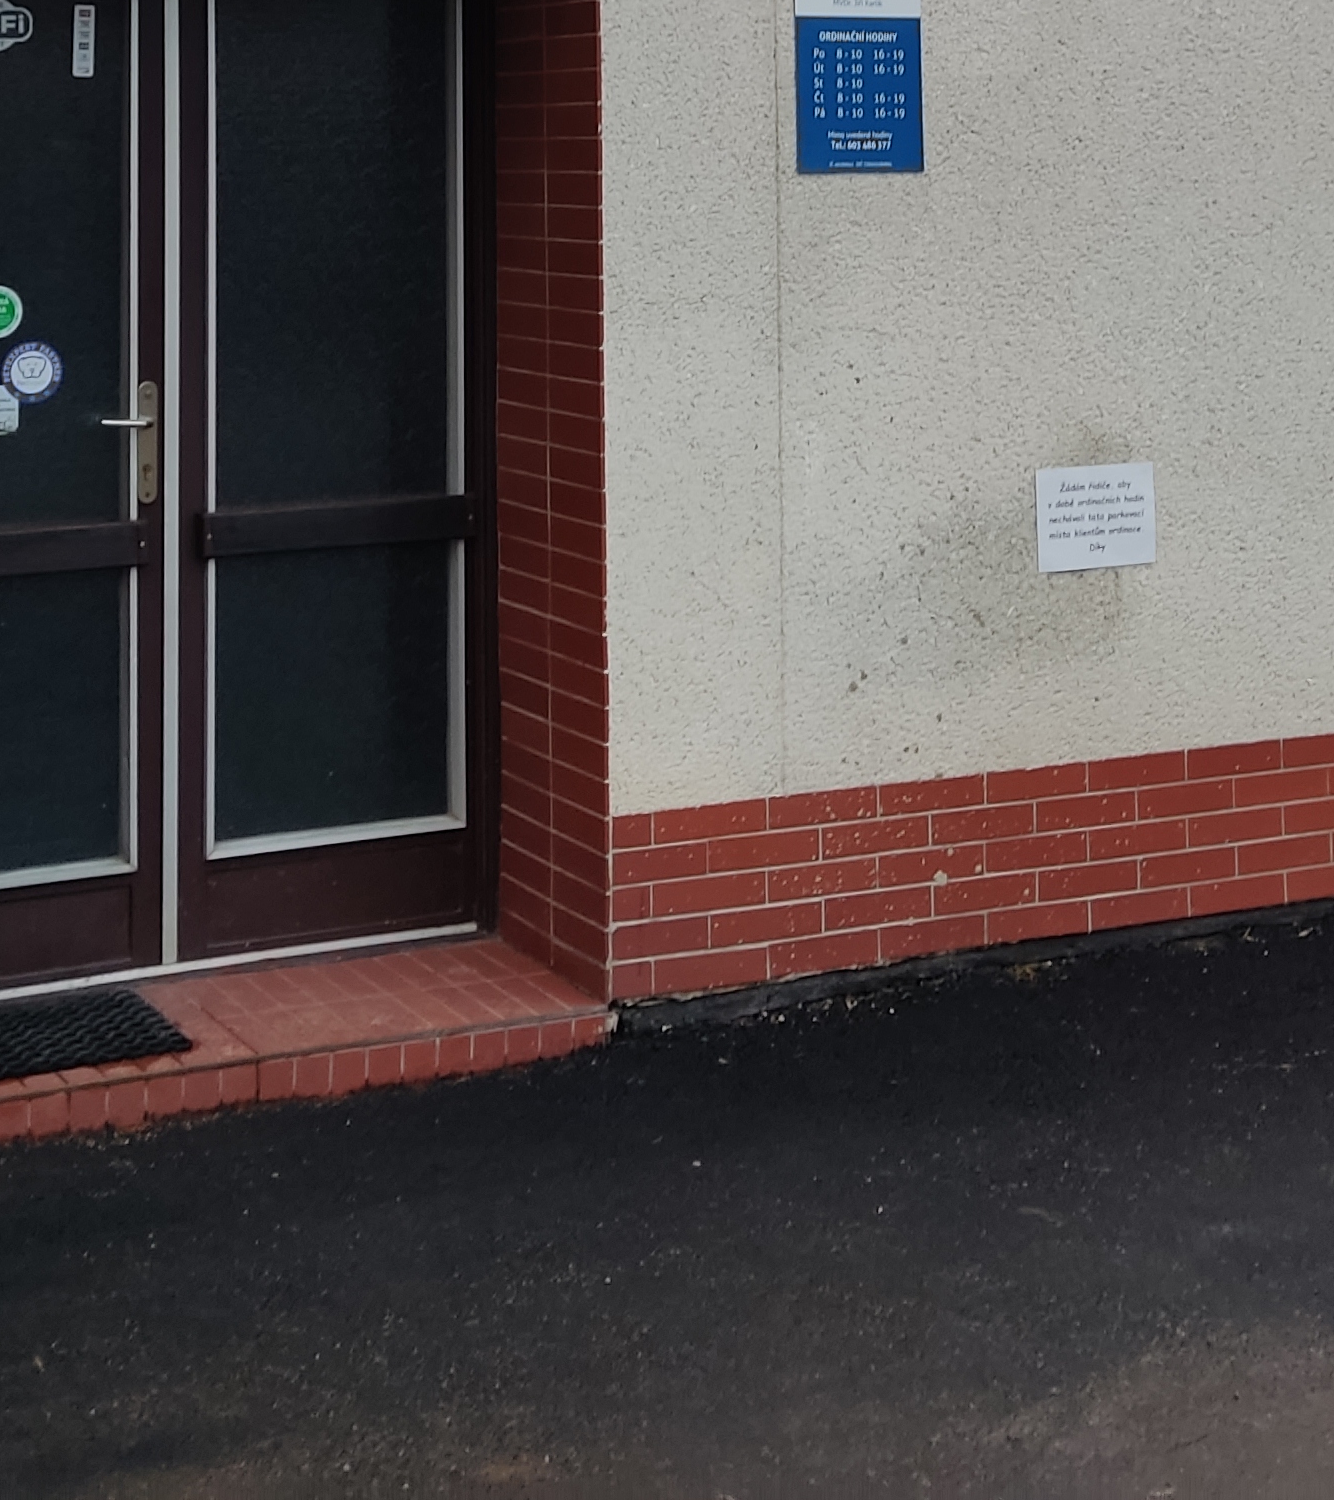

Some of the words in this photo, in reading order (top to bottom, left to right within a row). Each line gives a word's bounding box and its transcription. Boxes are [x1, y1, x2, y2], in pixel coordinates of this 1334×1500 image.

[819, 30, 864, 42] ORDINAČNÍ
[866, 32, 897, 43] HODINY
[813, 47, 825, 59] Po
[836, 48, 842, 59] 8
[851, 49, 862, 60] 10
[874, 49, 885, 60] 16
[893, 49, 904, 61] 19
[814, 61, 824, 74] Út
[836, 63, 842, 74] 8
[851, 63, 862, 74] 10
[874, 63, 885, 75] 16
[893, 64, 904, 75] 19
[814, 77, 823, 89] St
[837, 77, 843, 89] 8
[852, 78, 863, 89] 10
[814, 90, 824, 103] Čt
[837, 92, 843, 104] 8
[852, 93, 863, 104] 10
[874, 93, 885, 104] 16
[894, 93, 905, 104] 19
[814, 106, 825, 118] Pá
[837, 107, 843, 118] 8
[852, 107, 863, 118] 10
[875, 107, 886, 119] 16
[894, 108, 905, 119] 19
[1117, 480, 1131, 490] aby
